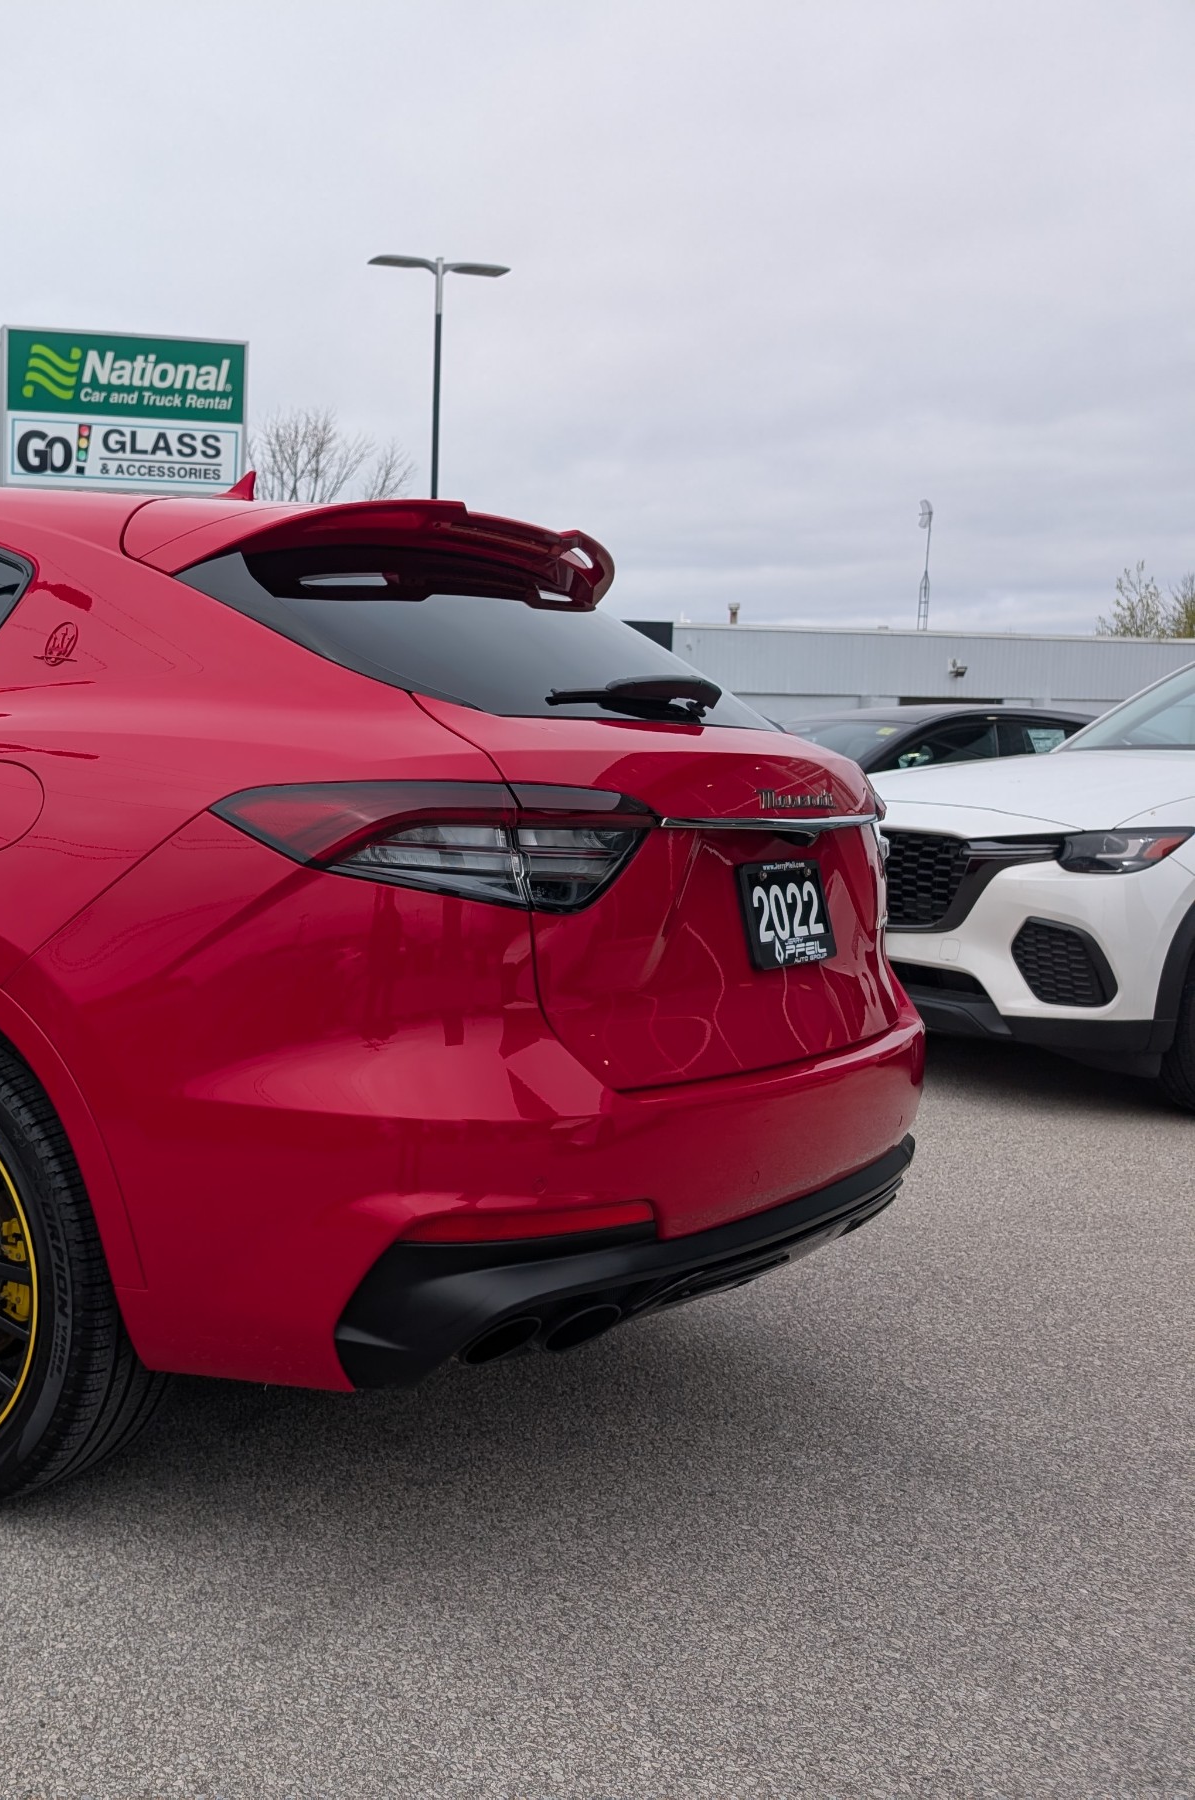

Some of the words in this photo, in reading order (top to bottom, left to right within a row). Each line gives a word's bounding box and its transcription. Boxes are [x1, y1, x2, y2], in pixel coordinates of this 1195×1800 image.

[80, 388, 106, 402] Car
[109, 390, 138, 405] and
[143, 392, 181, 407] Truck
[186, 394, 232, 410] Rental
[102, 428, 222, 460] GLASS
[100, 463, 110, 475] &
[115, 463, 222, 481] ACCESSORIES
[753, 881, 824, 942] 2022
[784, 936, 804, 946] JERRY
[785, 940, 827, 960] PFEIL
[794, 955, 809, 964] AUTO
[809, 952, 828, 961] GROUP
